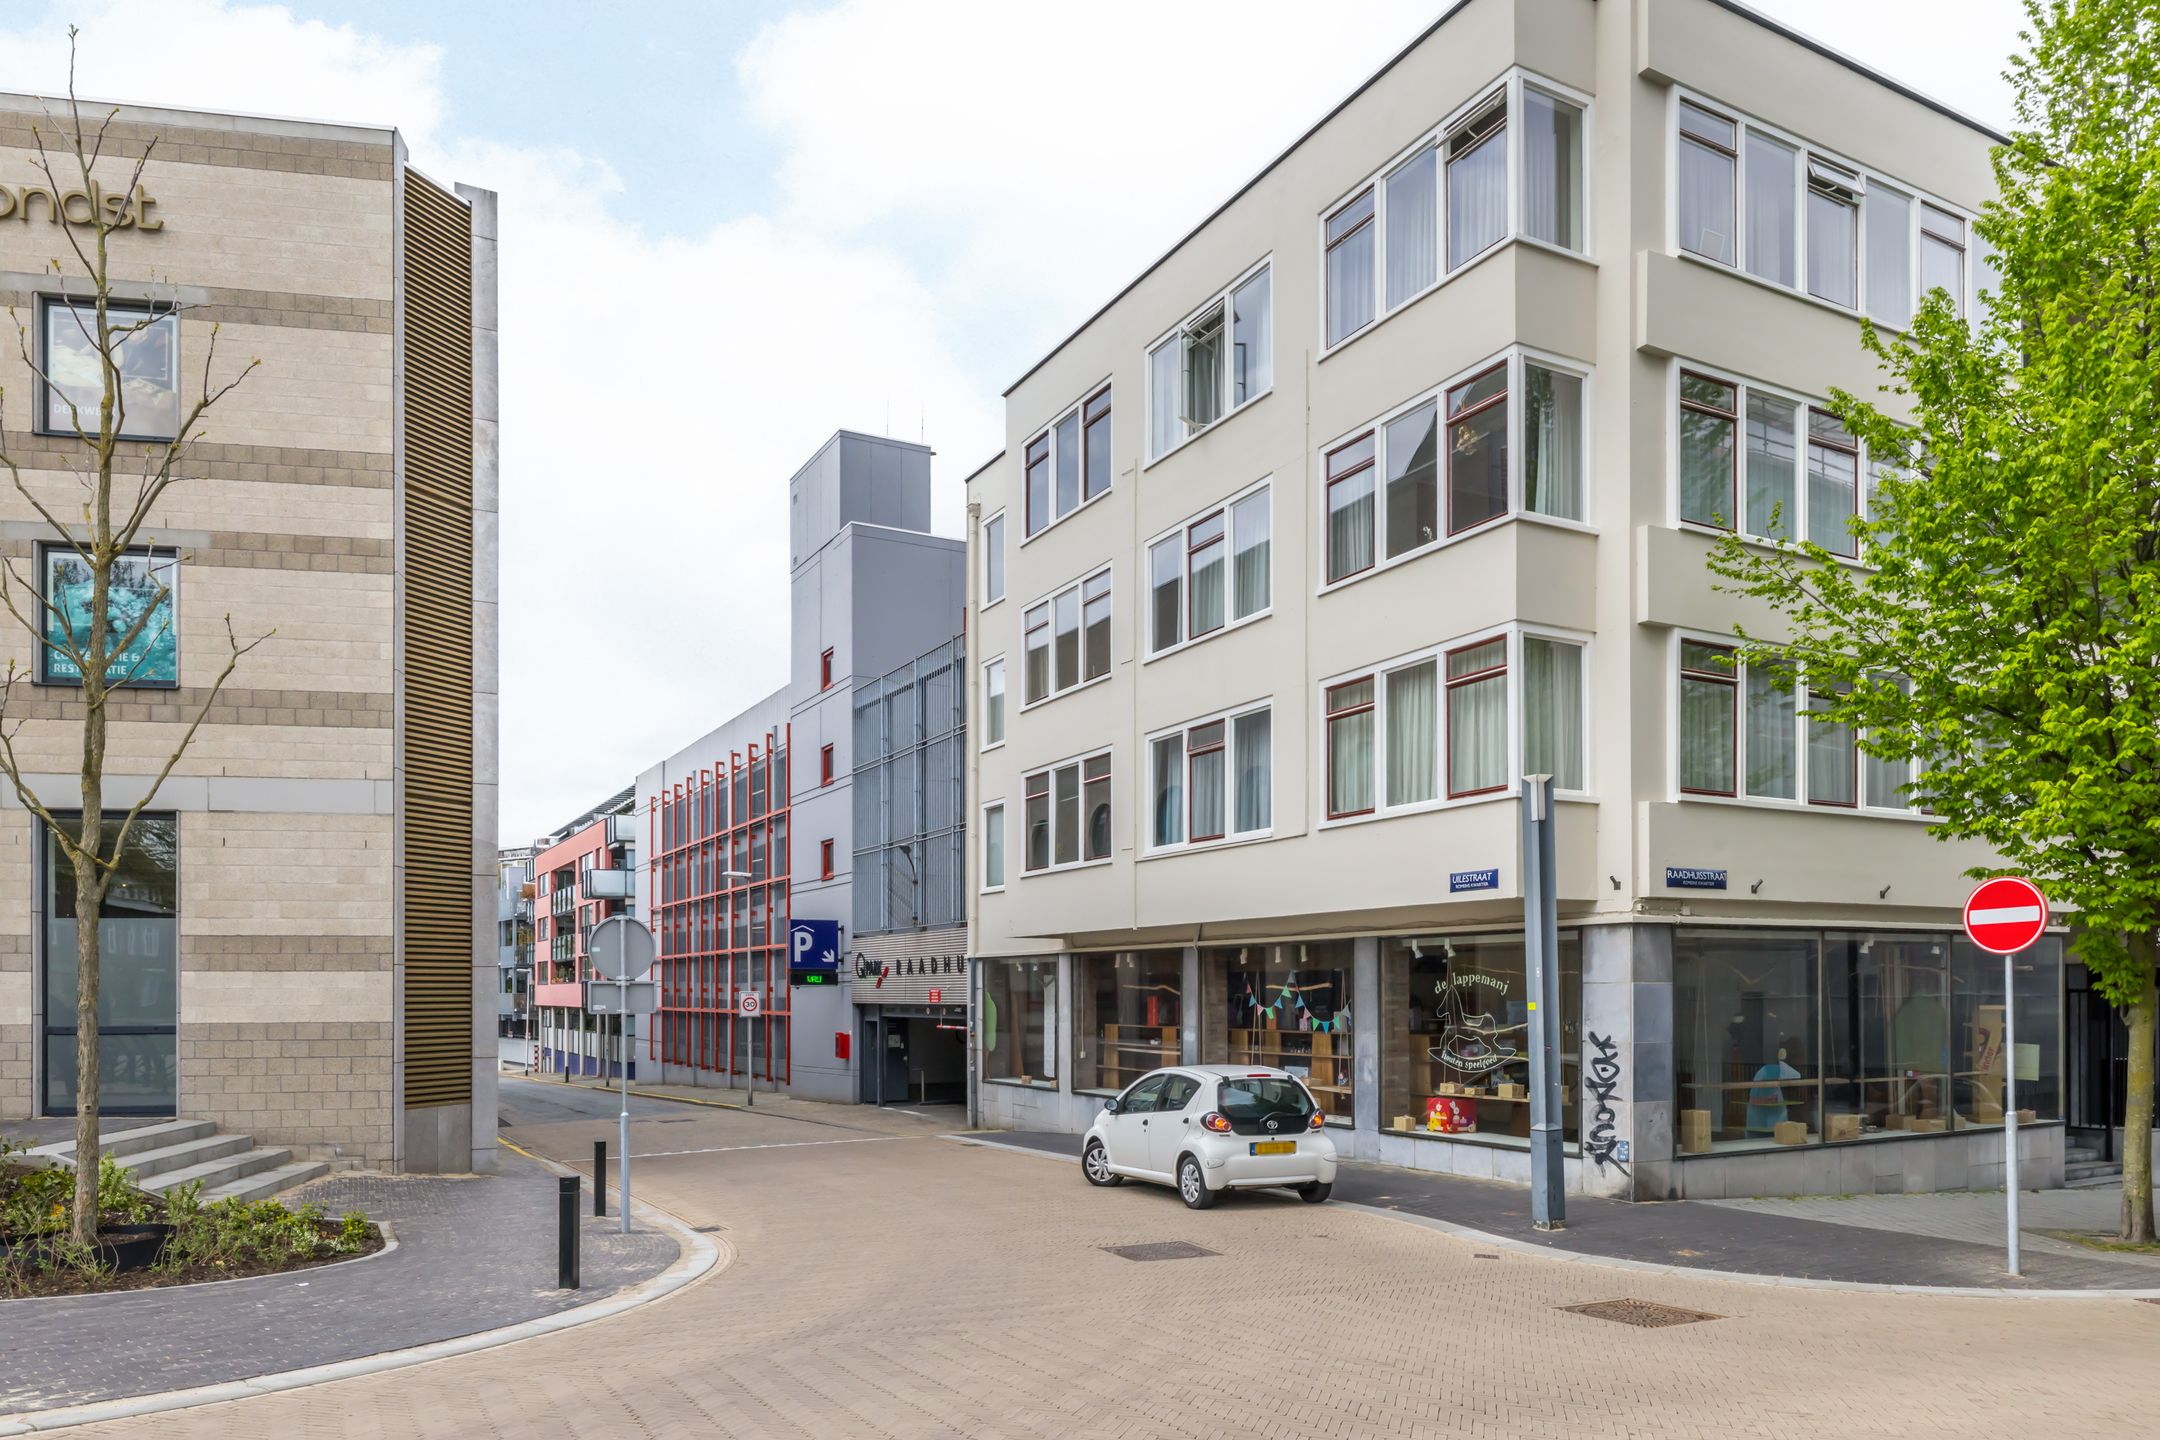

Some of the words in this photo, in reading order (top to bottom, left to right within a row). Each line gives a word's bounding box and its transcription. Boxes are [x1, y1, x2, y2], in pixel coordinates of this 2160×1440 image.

[131, 652, 140, 662] &
[1452, 872, 1493, 884] UILESTRAAT
[1667, 869, 1727, 881] RAADHUISSTRAAT
[794, 931, 813, 962] P
[1434, 980, 1448, 994] de
[1452, 972, 1510, 996] lappemanj
[1441, 1050, 1463, 1068] houten
[1464, 1054, 1498, 1070] speelgoed
